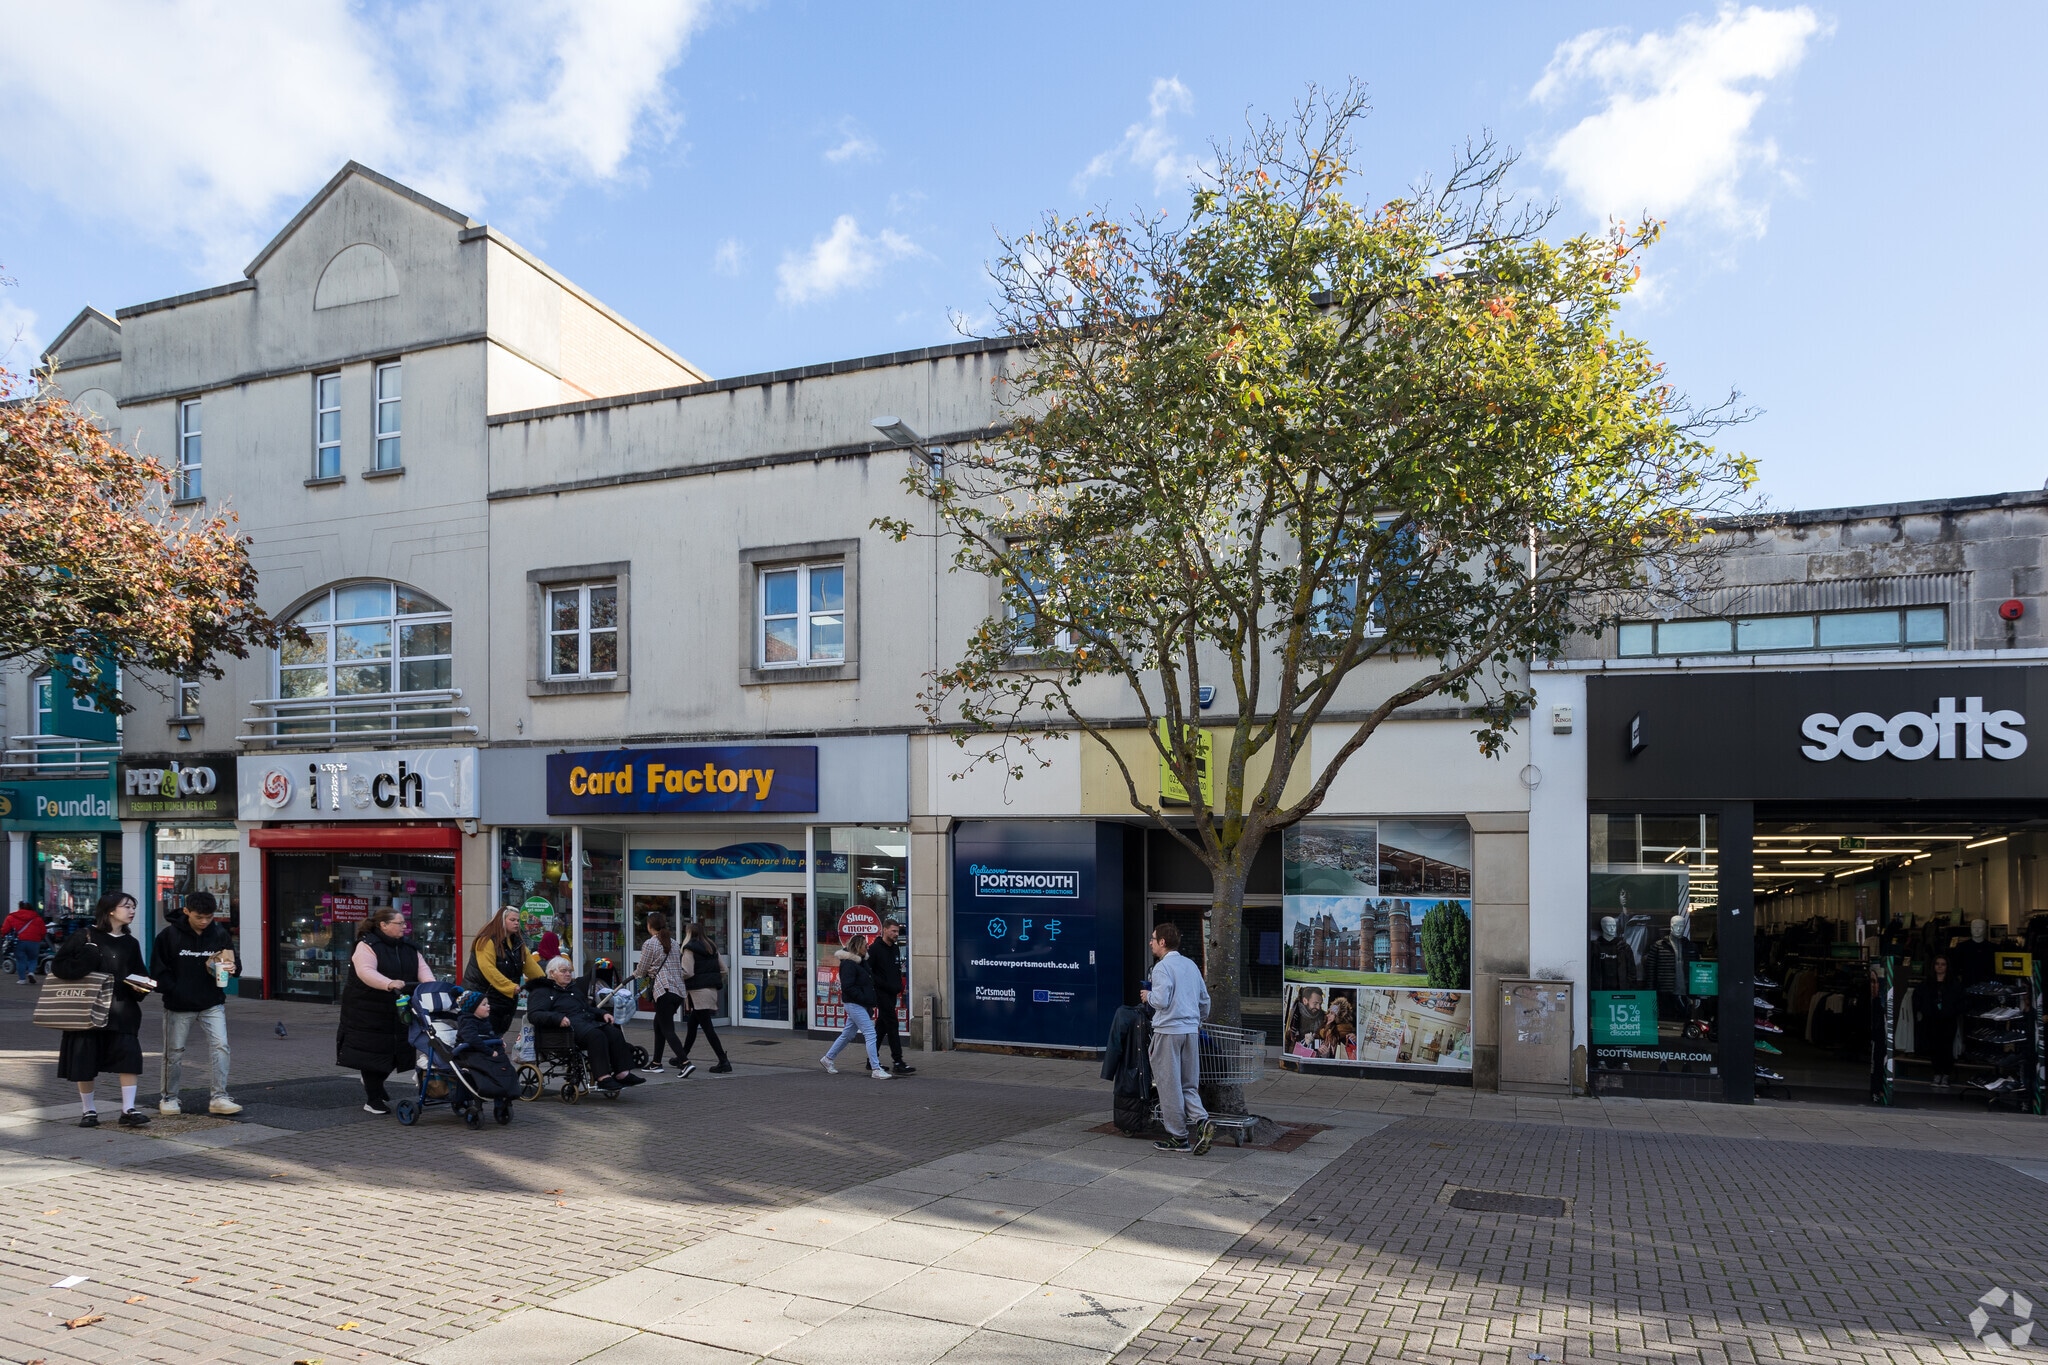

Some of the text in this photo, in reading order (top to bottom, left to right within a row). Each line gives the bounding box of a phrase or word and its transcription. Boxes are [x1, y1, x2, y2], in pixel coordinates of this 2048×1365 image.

[1801, 696, 2027, 762] scotts
[309, 759, 426, 811] iTech
[570, 763, 775, 801] Card Factory
[131, 801, 153, 812] FASHION
[153, 801, 164, 812] FOR
[187, 801, 199, 811] MEN
[204, 800, 217, 811] KIDS
[217, 859, 228, 871] £1
[645, 855, 682, 868] Compare
[684, 856, 698, 865] the
[740, 856, 779, 869] Compare
[782, 857, 796, 866] the
[969, 863, 1008, 876] Rediscover
[980, 875, 1073, 888] PORTSMOUTH
[846, 912, 874, 925] Share
[847, 925, 872, 934] more
[970, 959, 1080, 970] rediscoverportsmouth.co.uk
[55, 989, 87, 998] CELINE
[975, 986, 1016, 998] Portsmouth
[1629, 1015, 1641, 1024] off
[1609, 1022, 1641, 1031] student
[1609, 1029, 1641, 1037] discount
[1596, 1049, 1712, 1062] SCOTTSMENSWEAR.COM
